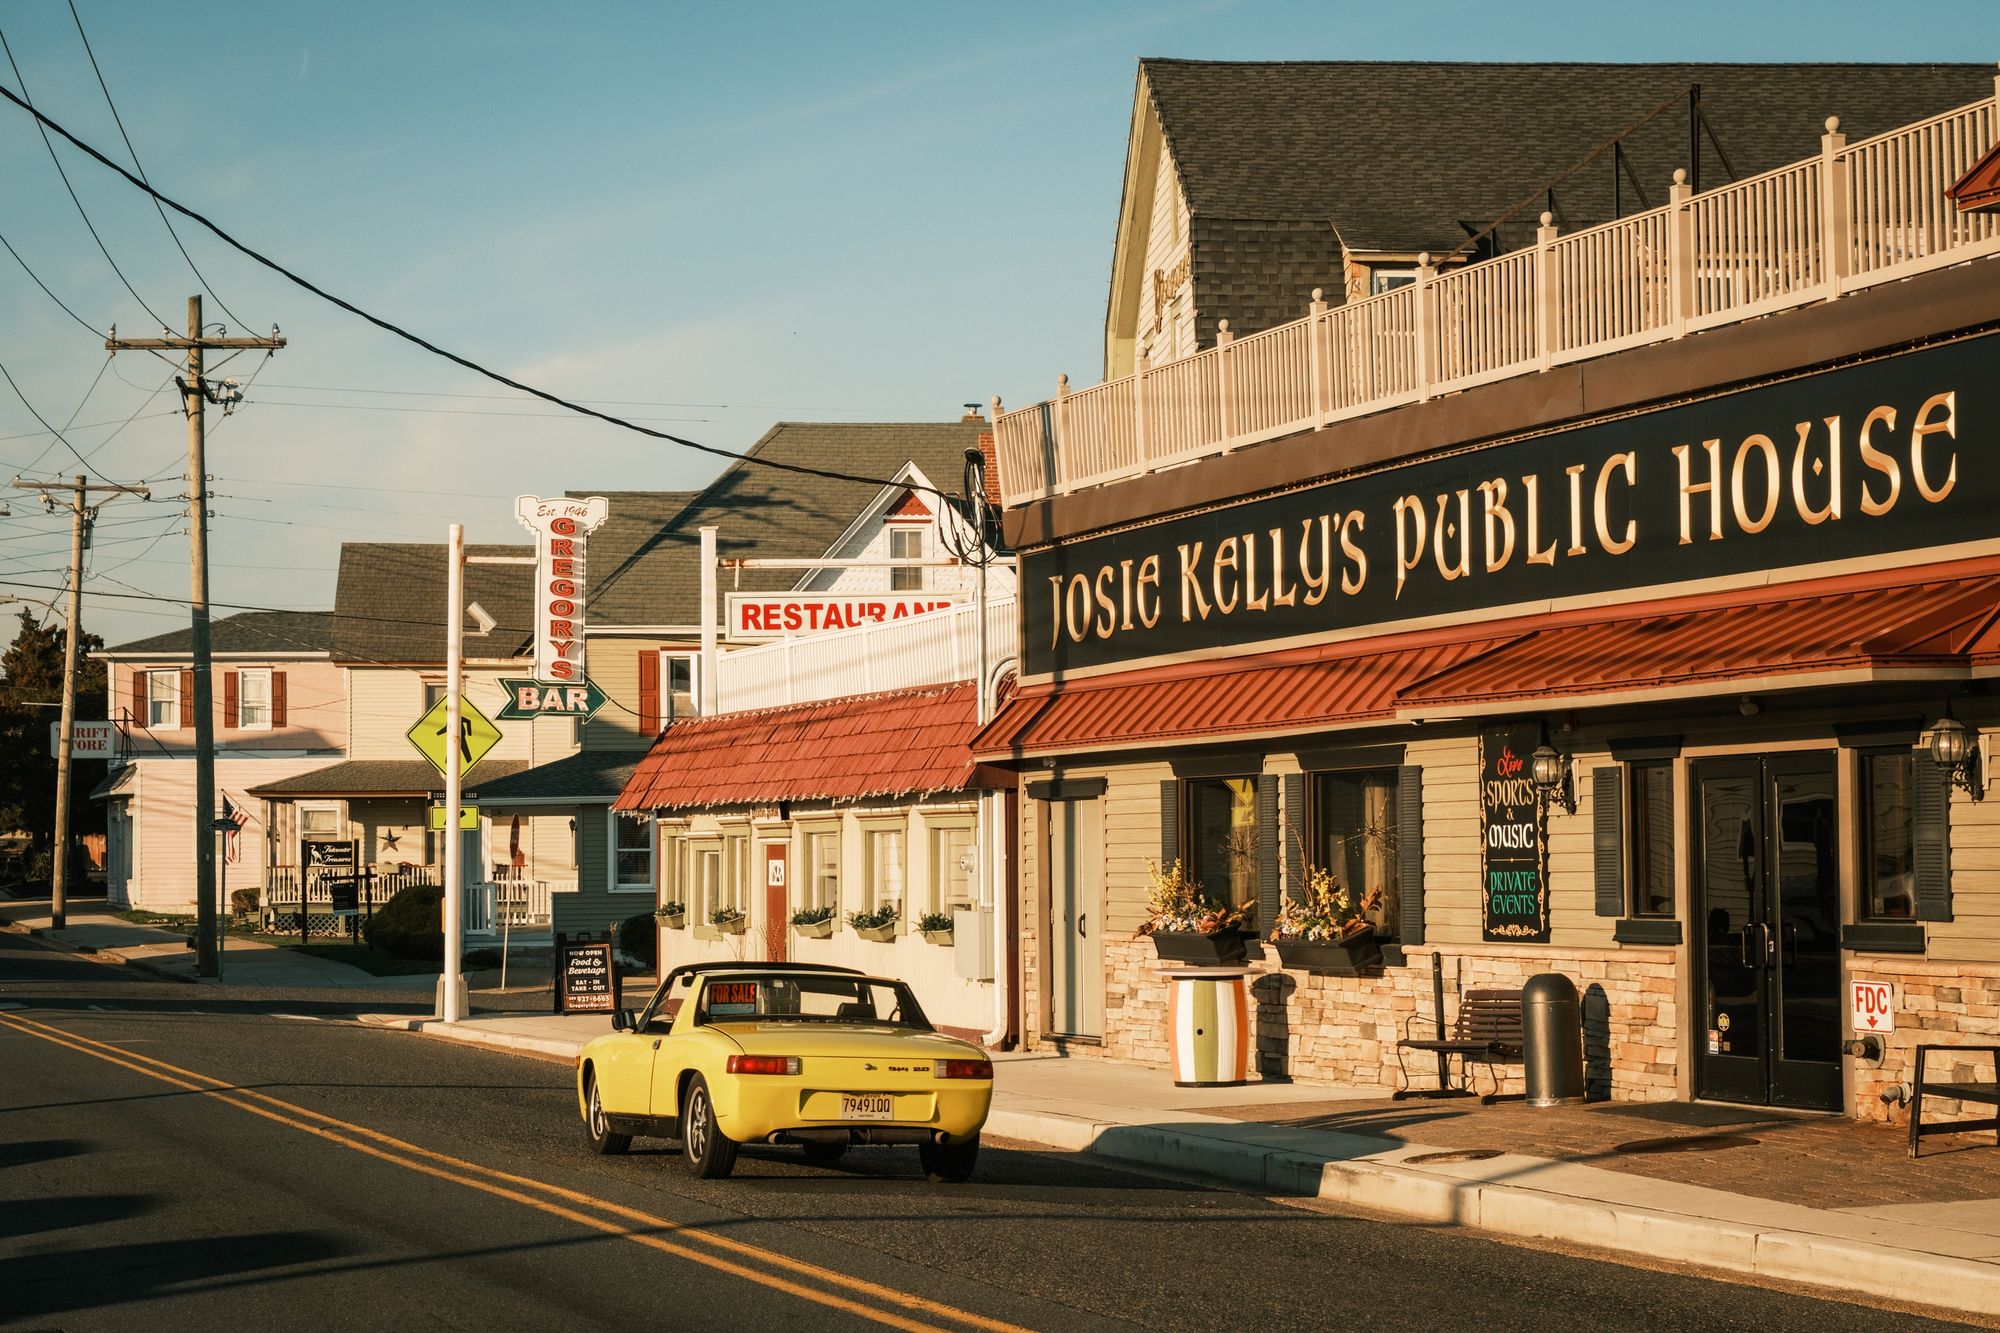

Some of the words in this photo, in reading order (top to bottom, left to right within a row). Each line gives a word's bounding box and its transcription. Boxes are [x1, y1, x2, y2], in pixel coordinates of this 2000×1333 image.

[563, 506, 588, 517] 1946
[1048, 553, 1161, 653] JOSIE
[1177, 508, 1368, 624] KELLY'S
[1392, 450, 1638, 602] PUBLIC
[1671, 390, 1957, 546] HOUSE
[549, 517, 576, 679] GREGORYS
[517, 687, 590, 712] BAR
[1496, 745, 1523, 779] Live
[1486, 777, 1535, 813] SPORTS
[1506, 807, 1515, 821] &
[1488, 823, 1534, 850] MUSIC
[1490, 871, 1536, 896] PRIVATE
[1492, 894, 1535, 915] EVENTS
[568, 967, 606, 975] Beverage
[570, 958, 591, 966] Food
[593, 958, 602, 966] &
[711, 984, 730, 1003] FOR
[731, 983, 756, 1003] SALE
[1856, 986, 1887, 1014] FDC
